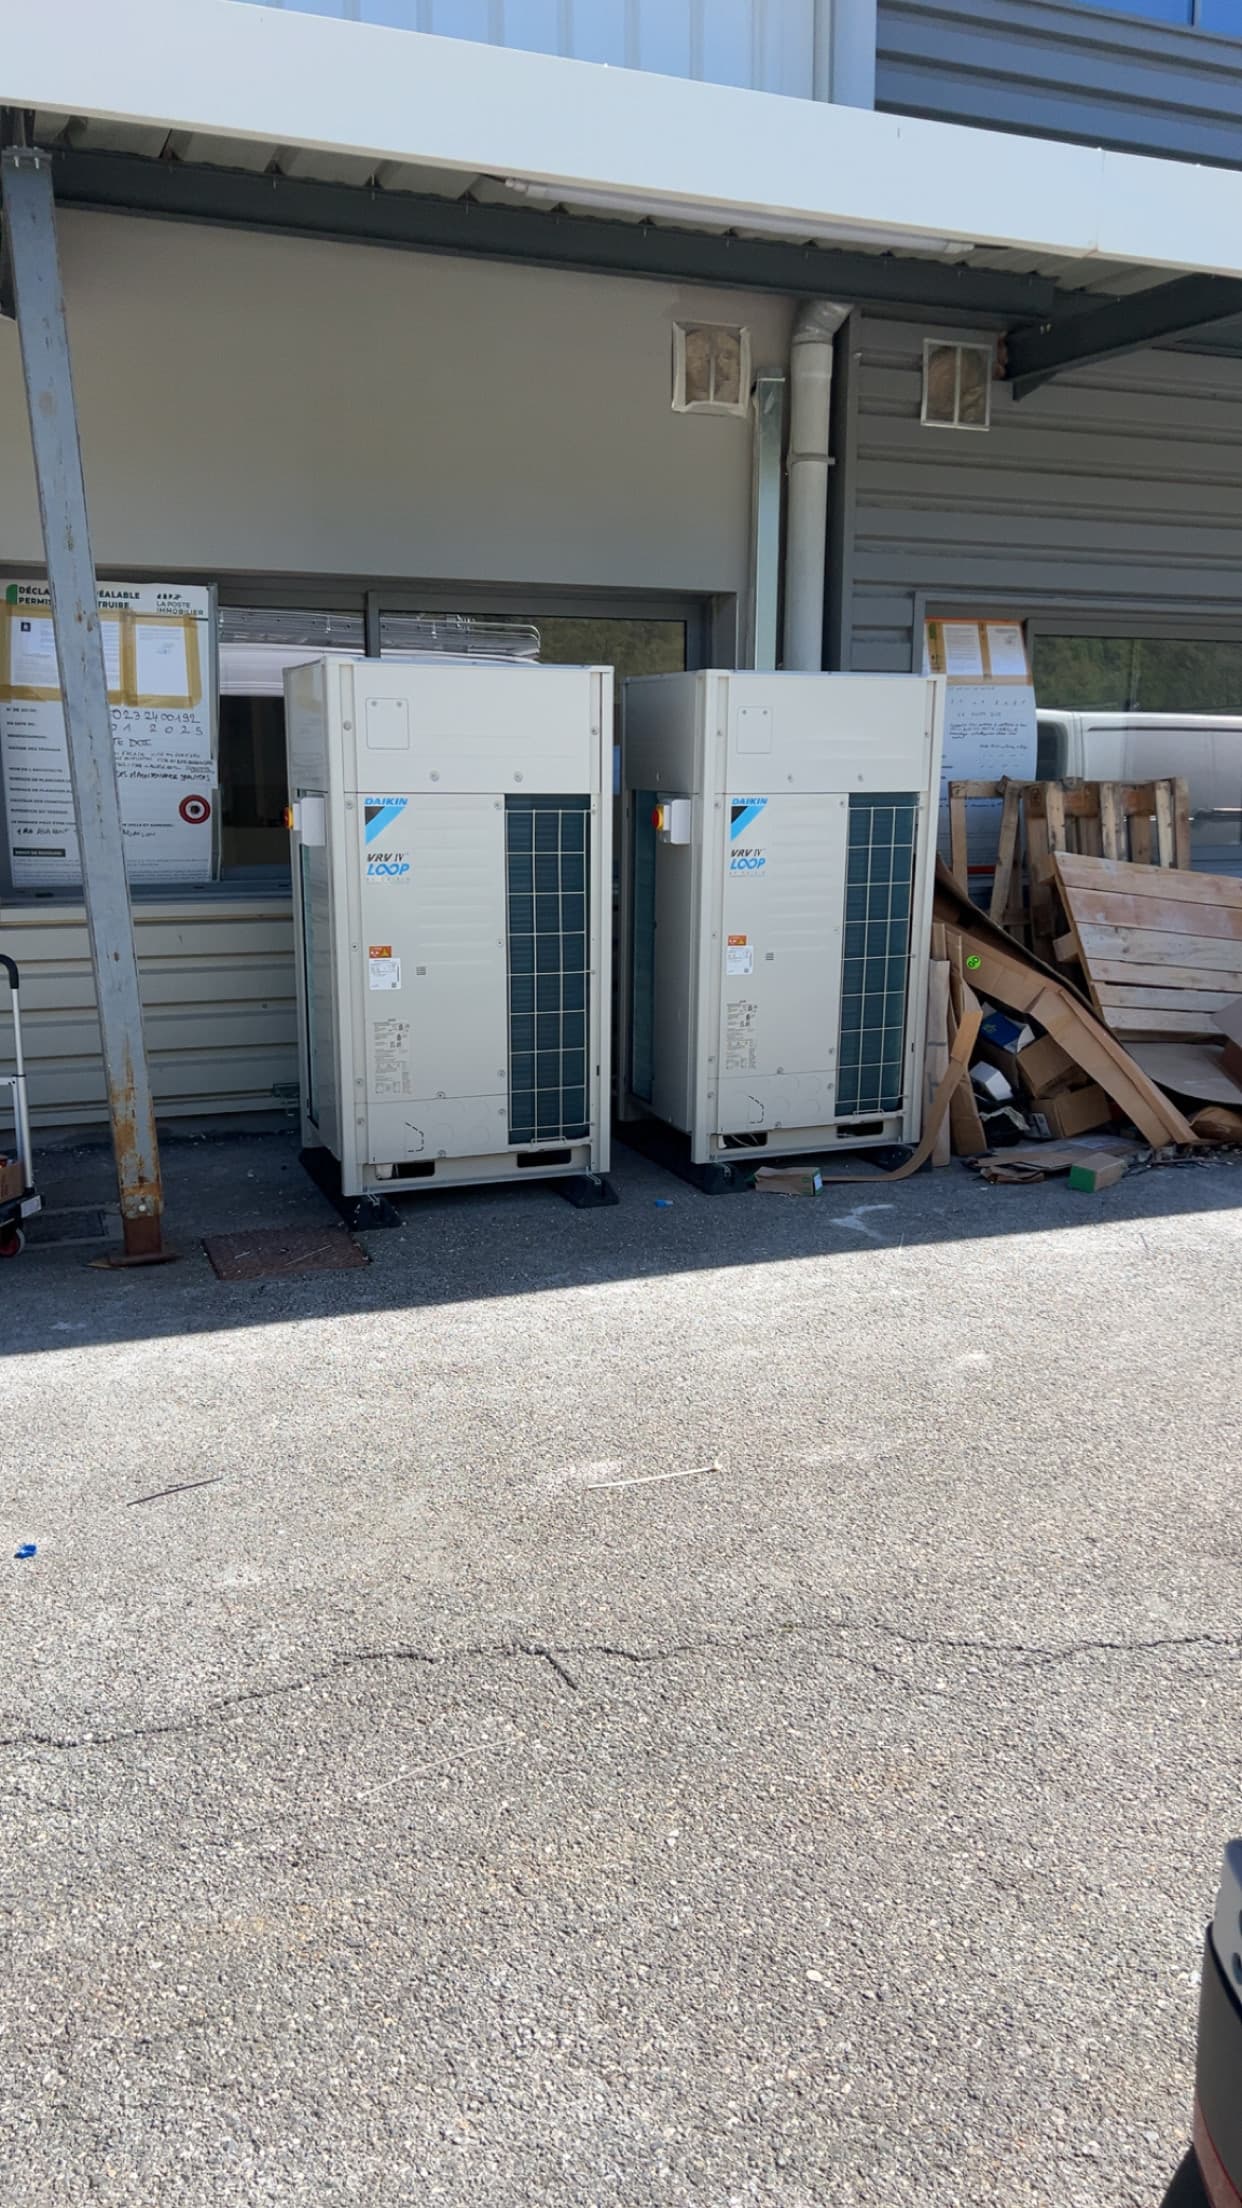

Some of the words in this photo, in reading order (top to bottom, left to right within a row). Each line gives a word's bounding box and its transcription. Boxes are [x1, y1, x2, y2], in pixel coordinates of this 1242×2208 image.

[18, 585, 50, 596] DÉCLA
[97, 589, 140, 600] ÉALABLE
[97, 600, 130, 609] TRUIRE
[167, 601, 191, 609] POSTE
[364, 797, 408, 806] DAIKIN
[731, 797, 768, 805] DAIKIN
[367, 852, 392, 862] VRV
[731, 848, 752, 857] VRV
[730, 857, 766, 870] LOOP
[367, 862, 410, 876] LOOP
